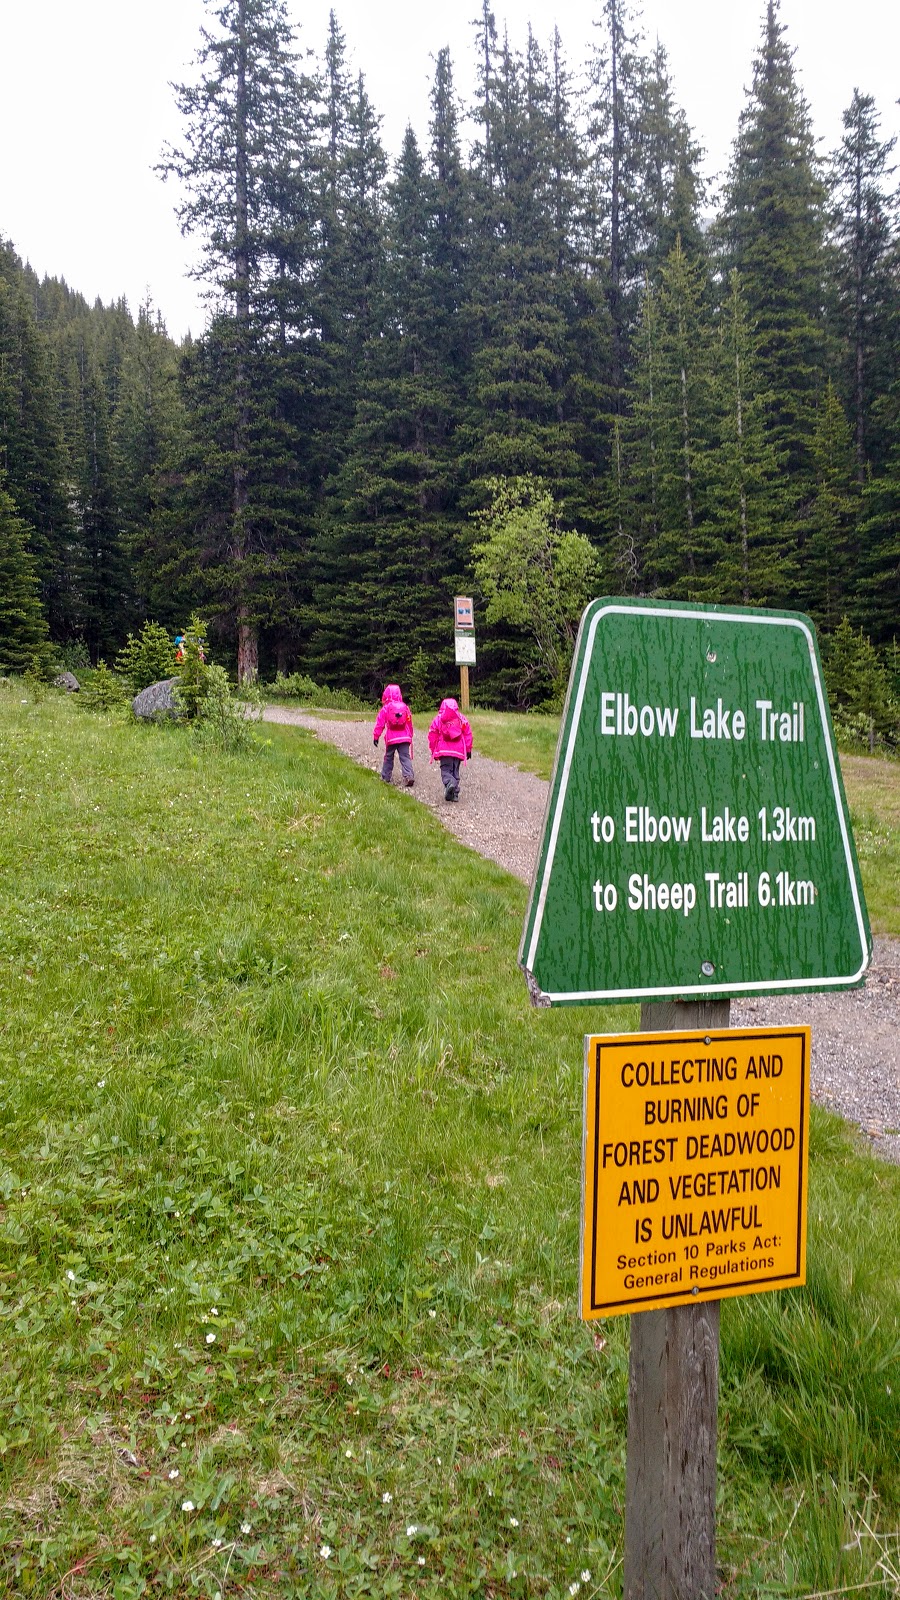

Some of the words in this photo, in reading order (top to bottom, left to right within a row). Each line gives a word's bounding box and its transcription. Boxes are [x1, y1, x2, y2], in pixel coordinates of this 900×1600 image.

[601, 692, 679, 737] Elbow
[690, 696, 746, 741] Lake
[755, 699, 805, 742] Trail
[591, 810, 615, 843] to
[625, 806, 692, 843] Elbow
[701, 806, 750, 842] Lake
[758, 806, 816, 842] 1.3km
[592, 878, 618, 912] to
[627, 873, 697, 917] Sheep
[704, 872, 749, 909] Trail
[757, 871, 815, 907] 6.1km
[620, 1056, 738, 1088] COLLECTING
[745, 1054, 784, 1080] AND
[644, 1094, 729, 1125] BURNING
[736, 1092, 761, 1118] OF
[602, 1137, 679, 1169] FOREST
[686, 1127, 796, 1161] DEADWOOD
[617, 1178, 660, 1207] AND
[668, 1164, 782, 1200] VEGETATION
[634, 1217, 653, 1244] IS
[661, 1204, 763, 1240] UNLAWFUL
[616, 1250, 677, 1270] Section
[683, 1244, 700, 1260] 10
[706, 1240, 747, 1257] Parks
[752, 1235, 782, 1250] Act:
[623, 1267, 683, 1289] General
[689, 1256, 775, 1280] Regulations
